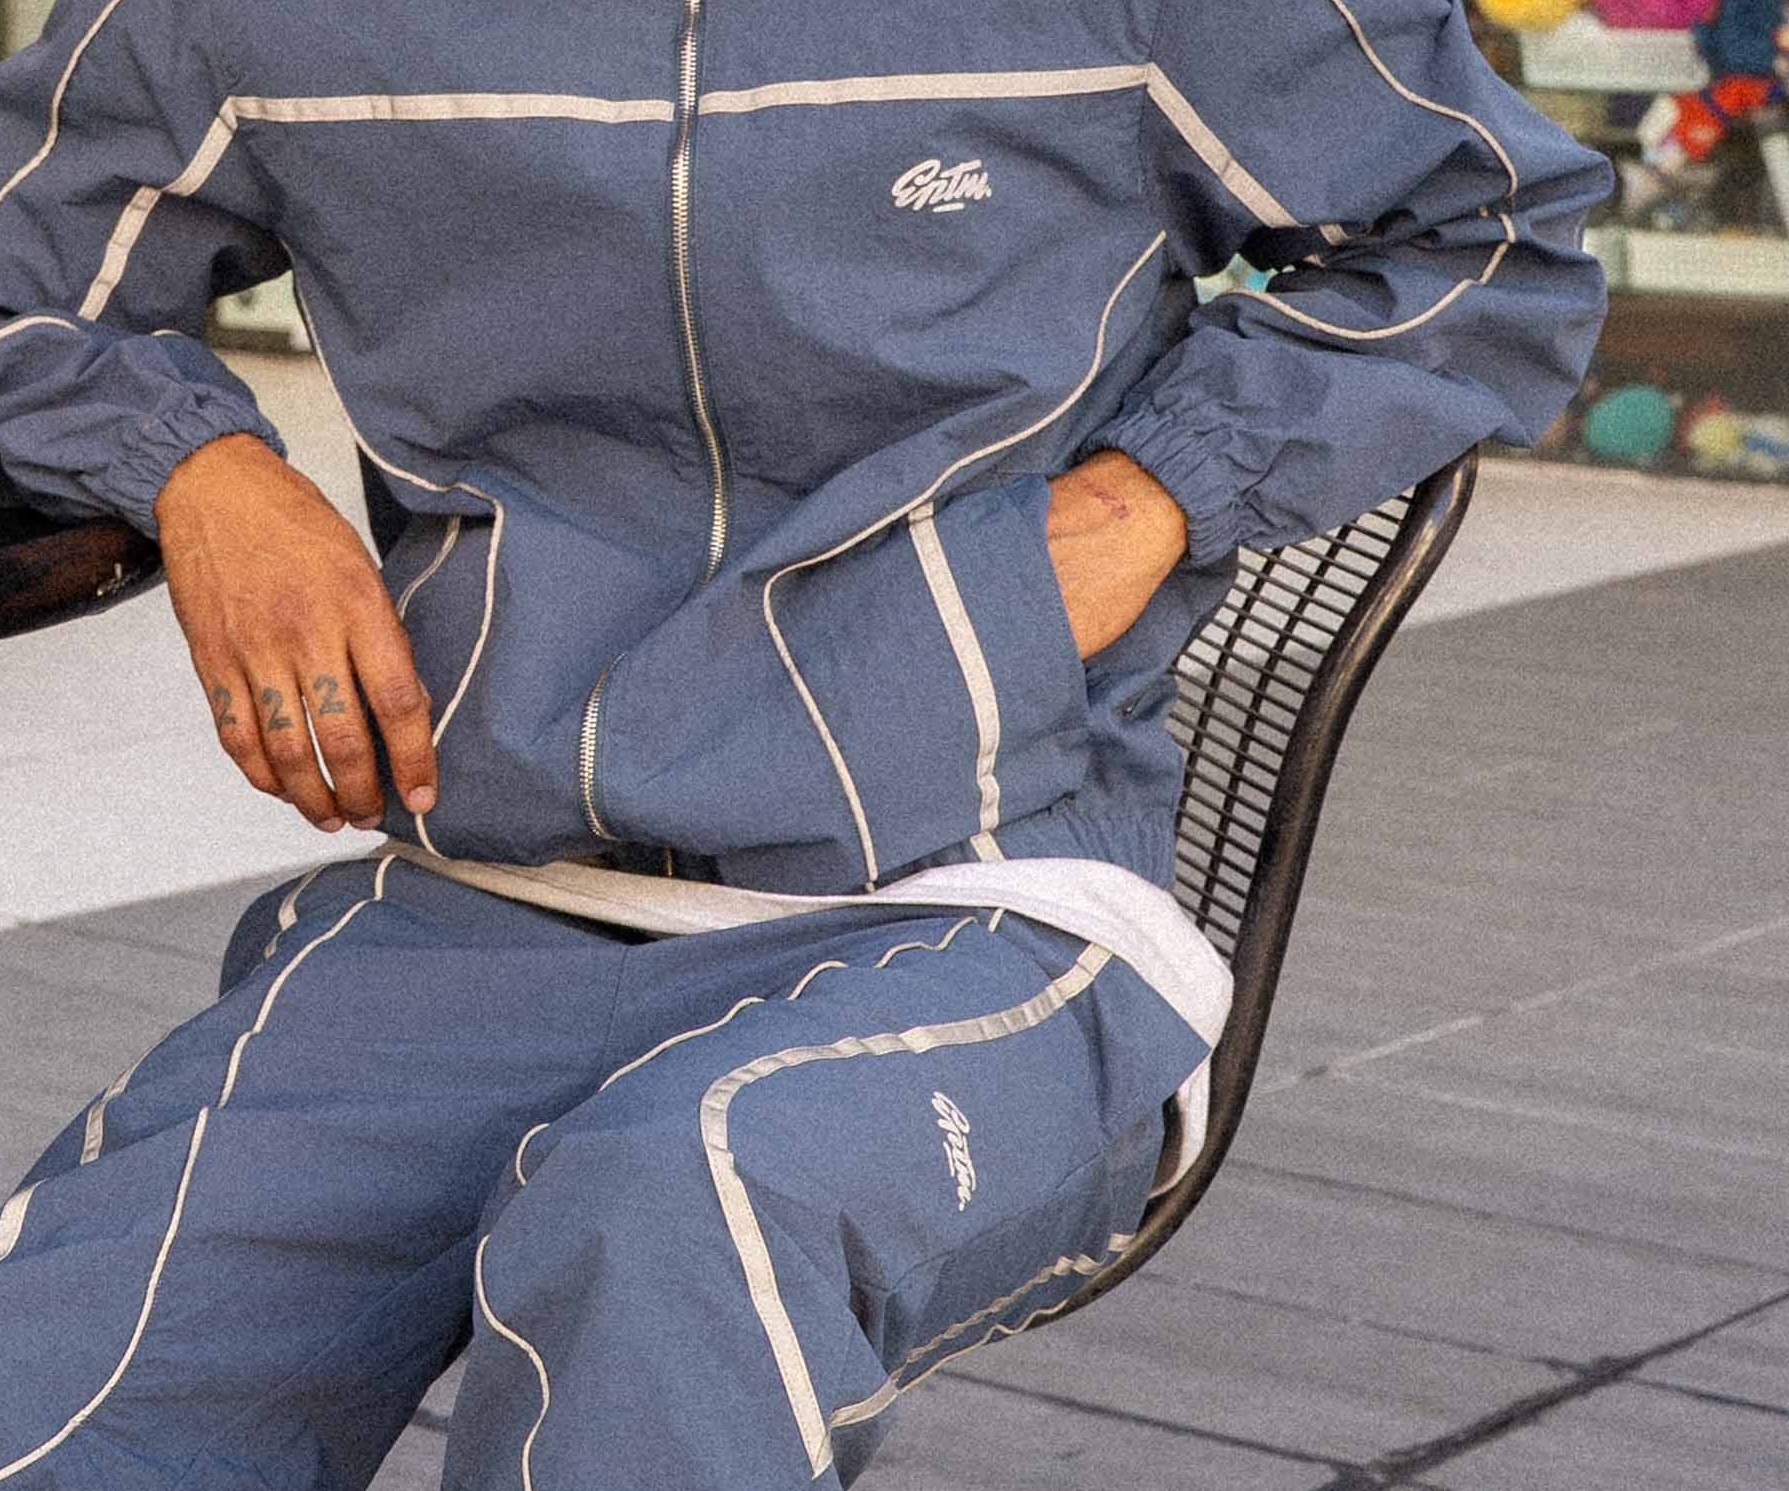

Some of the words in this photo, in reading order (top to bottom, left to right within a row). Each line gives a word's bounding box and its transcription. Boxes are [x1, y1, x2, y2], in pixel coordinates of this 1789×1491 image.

[211, 684, 237, 730] 2
[260, 687, 293, 730] 2
[312, 674, 347, 715] 2
